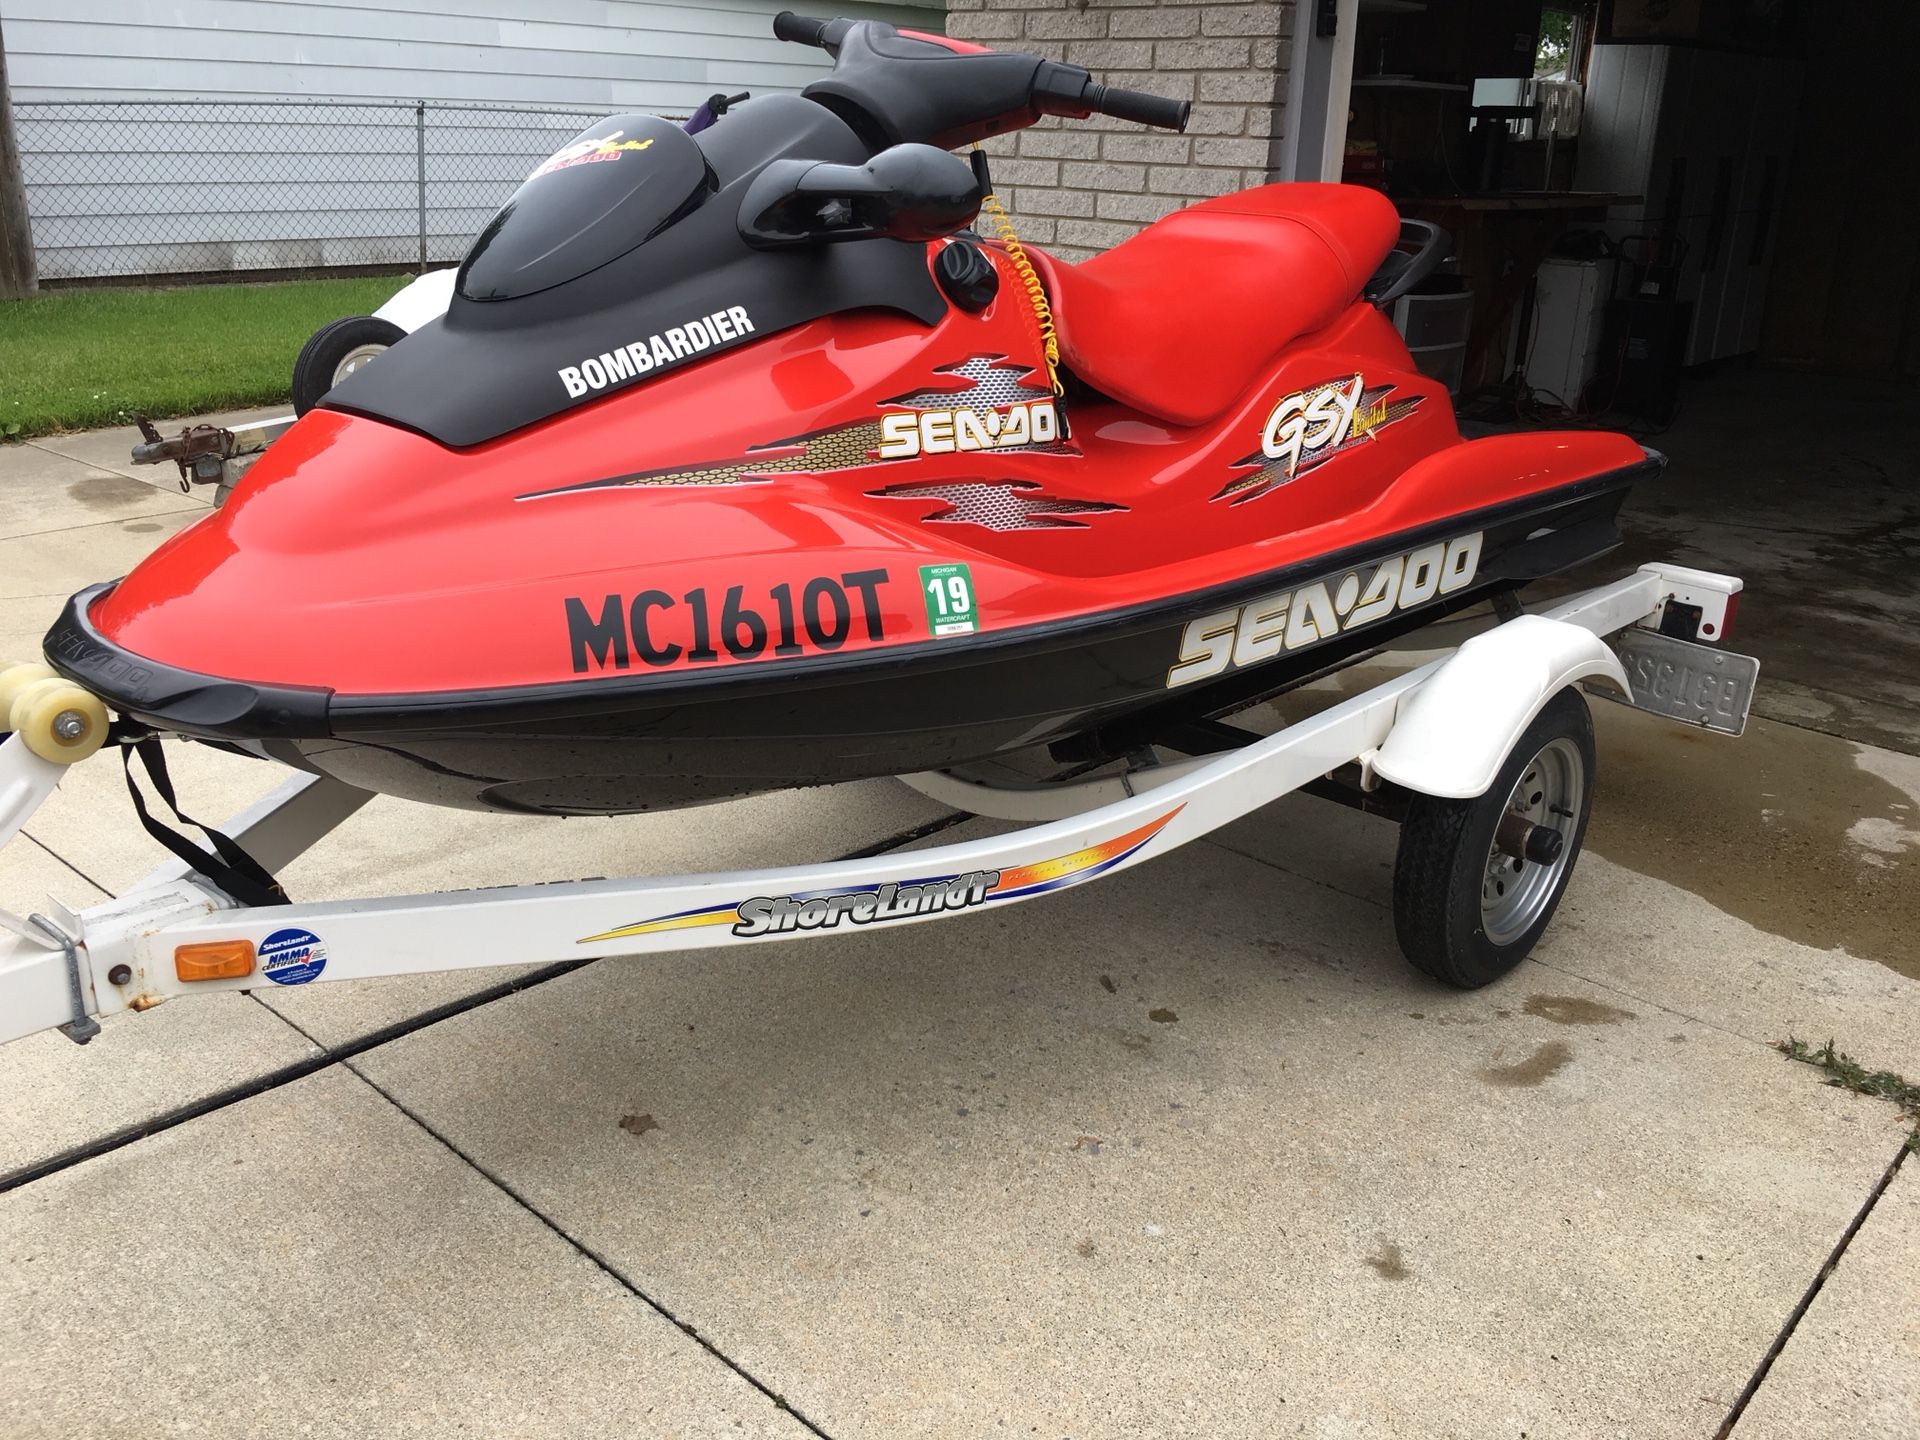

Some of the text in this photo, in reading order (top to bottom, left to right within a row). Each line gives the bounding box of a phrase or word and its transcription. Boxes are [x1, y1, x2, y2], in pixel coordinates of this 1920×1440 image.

[557, 305, 756, 399] BOMBARDIER
[927, 576, 970, 615] 19
[564, 568, 889, 673] MC1610T
[935, 614, 970, 624] WATERCRAFT
[261, 959, 301, 972] CERTIFIED
[268, 947, 310, 966] NMMA
